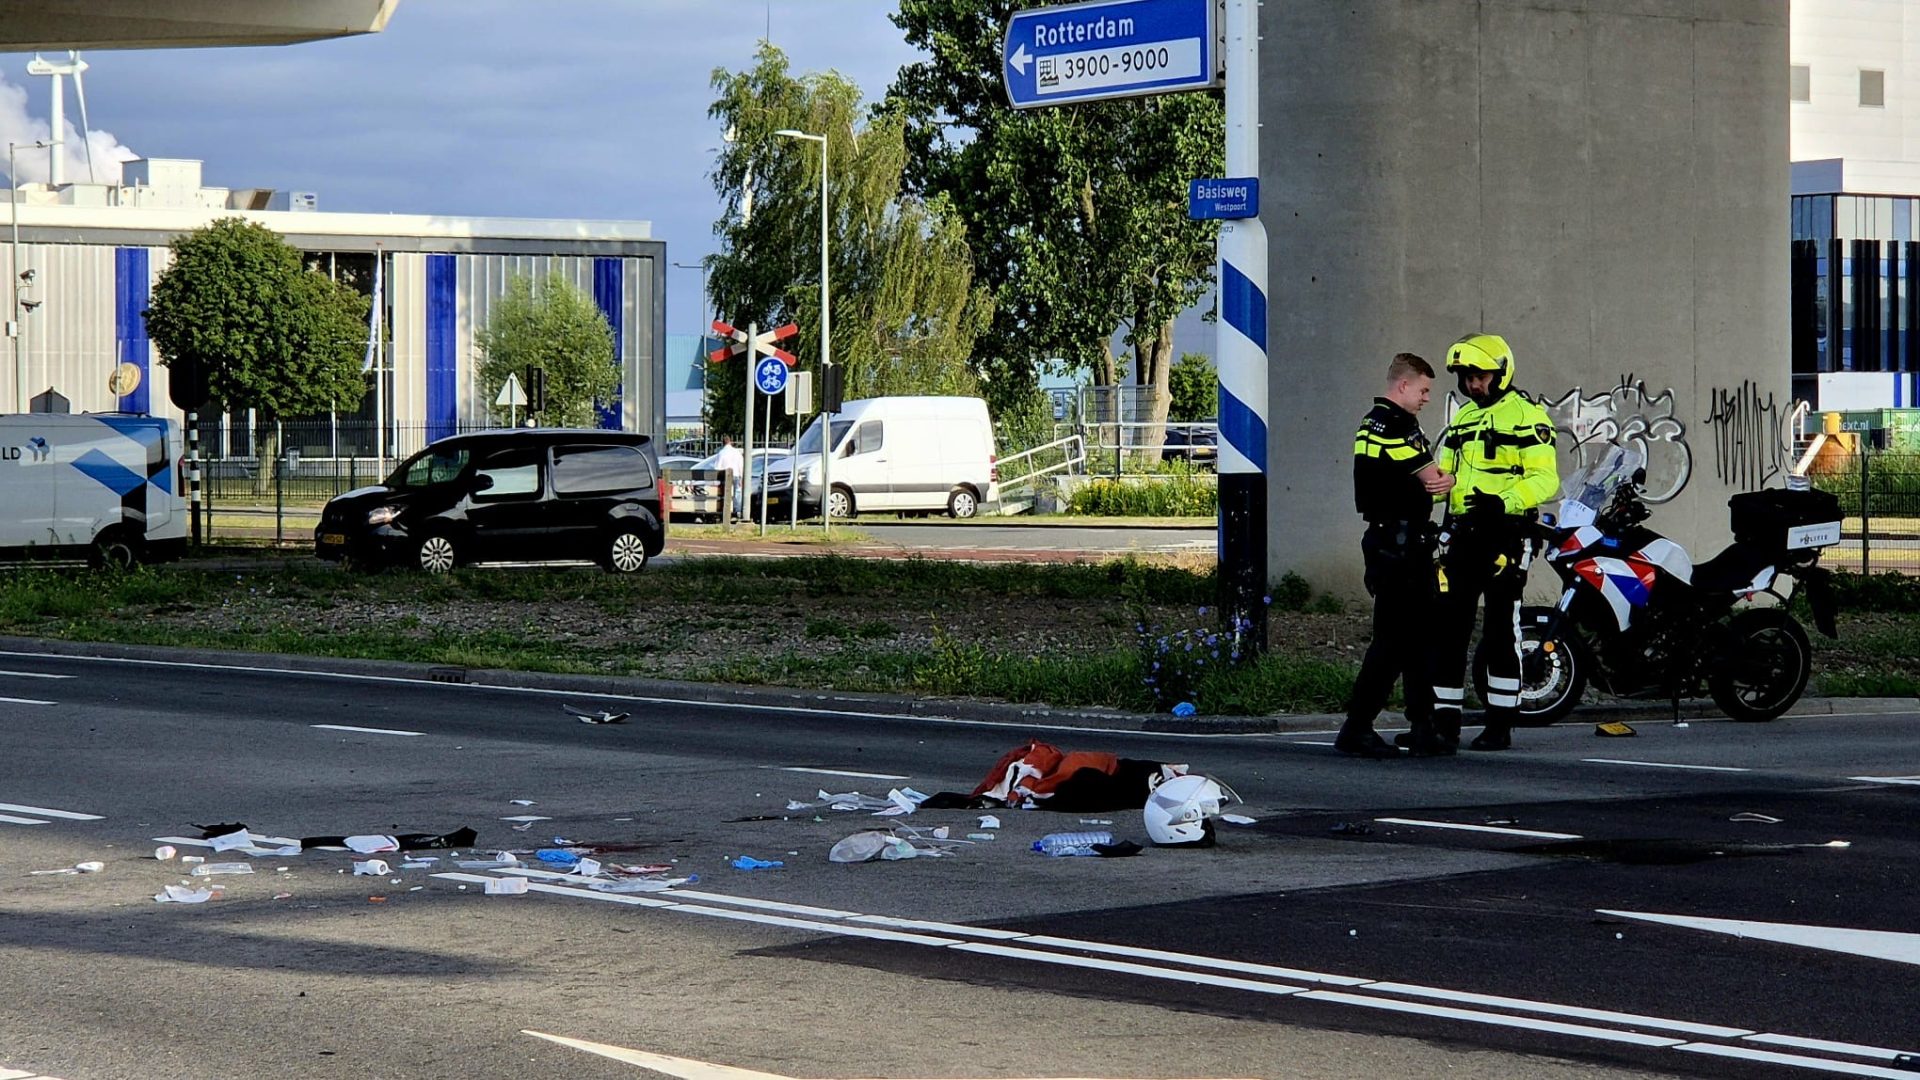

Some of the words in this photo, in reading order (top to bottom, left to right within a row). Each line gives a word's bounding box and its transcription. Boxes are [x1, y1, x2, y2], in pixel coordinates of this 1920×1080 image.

[1035, 16, 1135, 48] Rotterdam
[1065, 47, 1169, 80] 3900-9000
[1197, 185, 1247, 202] Basisweg
[1215, 202, 1247, 213] Westpoort
